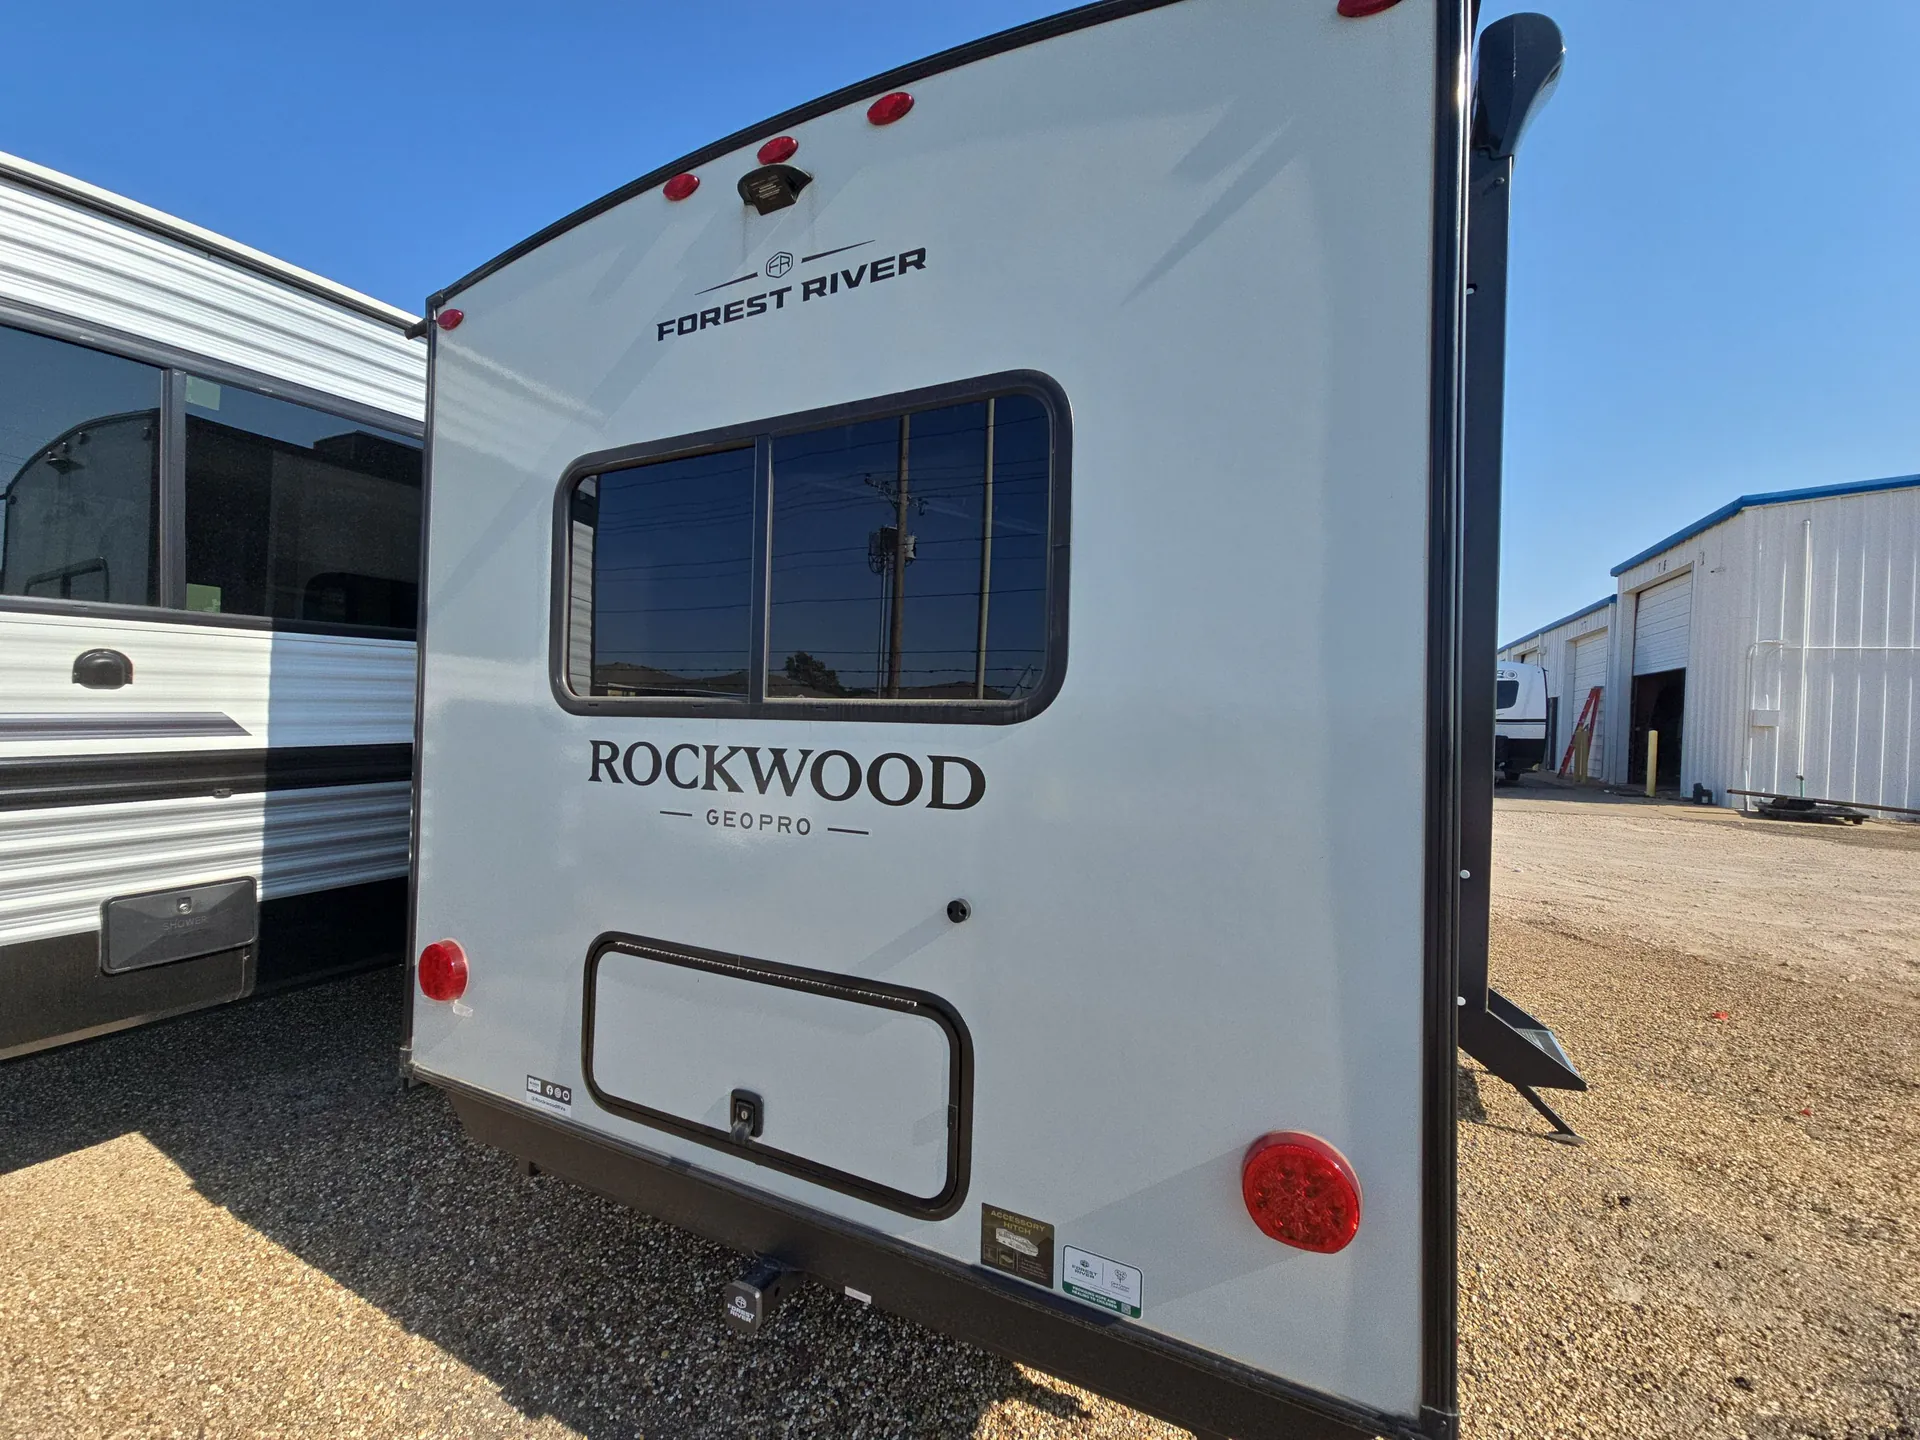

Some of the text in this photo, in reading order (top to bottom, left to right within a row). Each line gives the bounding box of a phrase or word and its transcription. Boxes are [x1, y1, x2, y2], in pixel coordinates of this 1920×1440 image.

[656, 247, 927, 342] FOREST RIVER
[588, 740, 986, 810] ROCKWOOD
[706, 808, 811, 836] GEOPRO
[163, 915, 208, 931] SHOWER
[990, 1210, 1046, 1233] ACCESSORY
[1003, 1221, 1032, 1236] HITCH
[1071, 1264, 1098, 1277] FOREST
